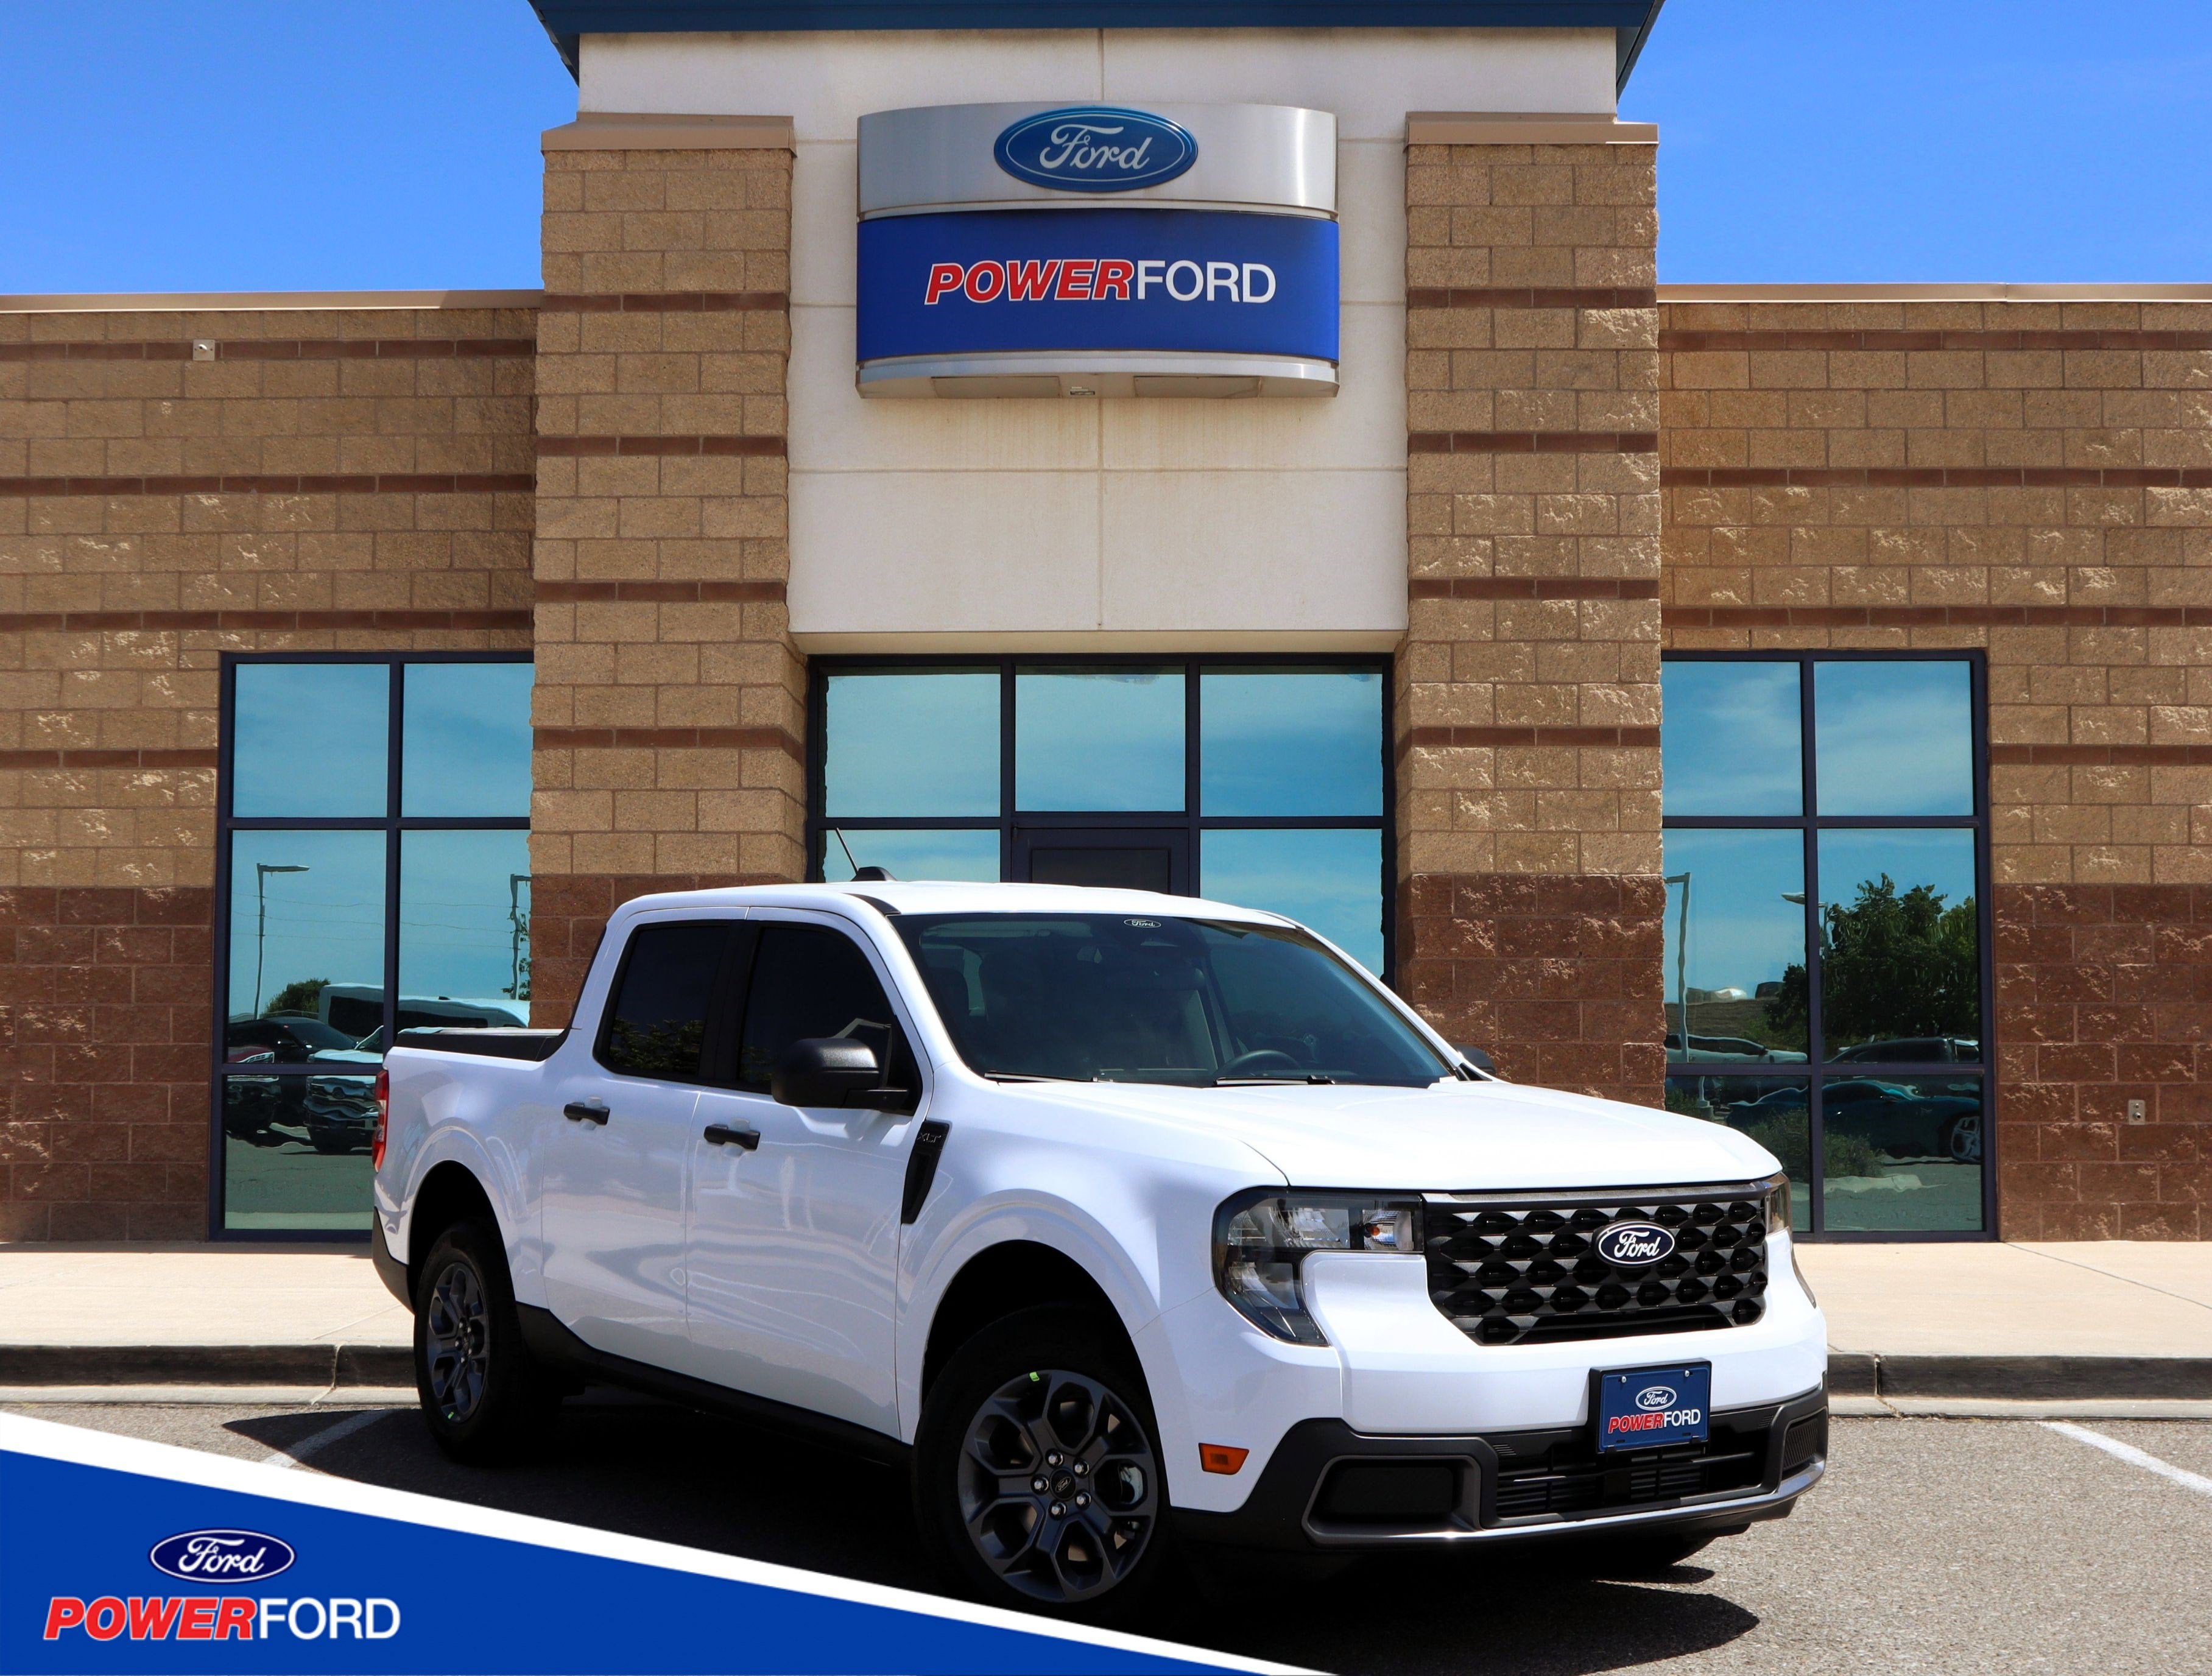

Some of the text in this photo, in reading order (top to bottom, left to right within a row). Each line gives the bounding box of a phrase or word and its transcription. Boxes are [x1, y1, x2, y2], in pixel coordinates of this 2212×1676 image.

[1039, 124, 1153, 170] Ford
[924, 259, 1277, 305] POWERFORD
[917, 1133, 942, 1143] XLT
[1614, 1230, 1661, 1258] Ford
[1644, 1390, 1668, 1406] Ford
[1608, 1409, 1701, 1434] POWERFORD
